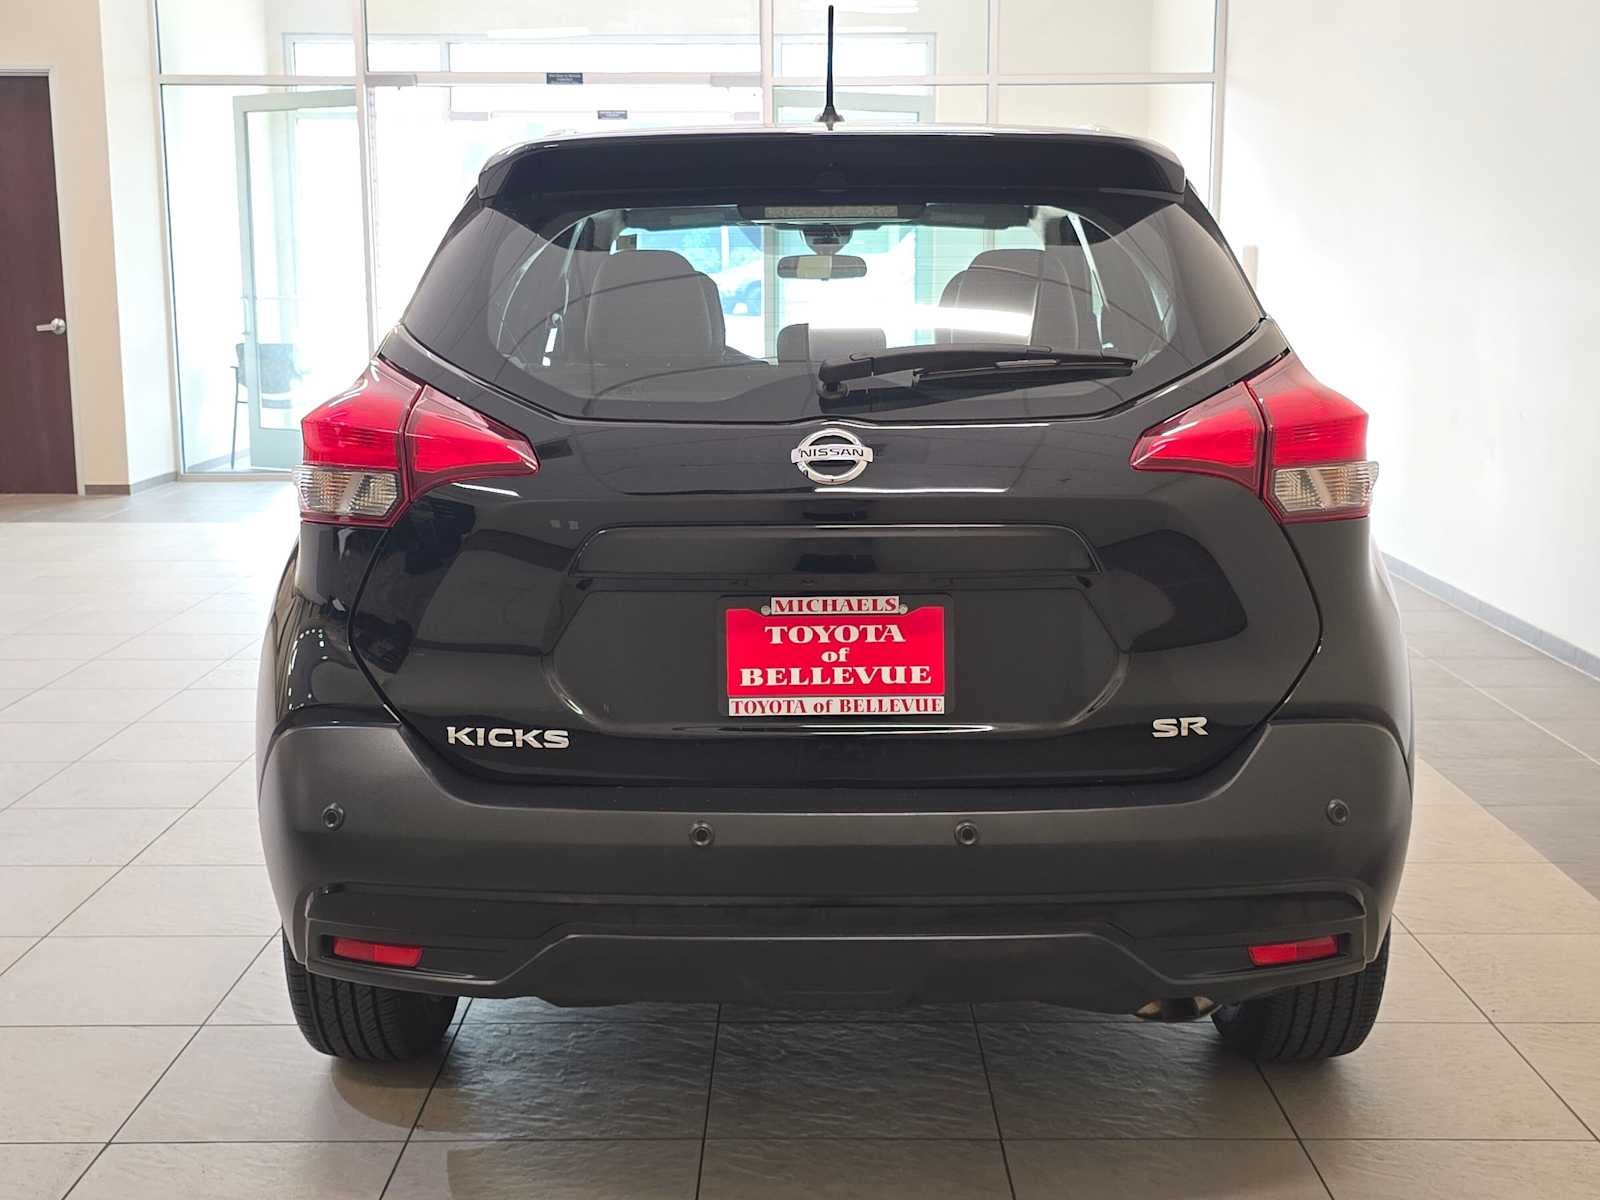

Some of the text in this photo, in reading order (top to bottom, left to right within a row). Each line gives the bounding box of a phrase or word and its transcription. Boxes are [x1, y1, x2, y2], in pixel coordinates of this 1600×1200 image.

[800, 447, 864, 458] NISSAN
[774, 598, 897, 612] MICHAELS
[764, 624, 905, 645] TOYOTA
[821, 647, 850, 663] of
[741, 665, 931, 687] BELLEVUE
[731, 698, 943, 714] TOYOTA of BELLEVUE
[1152, 716, 1209, 738] SR
[446, 726, 570, 748] KICKS
